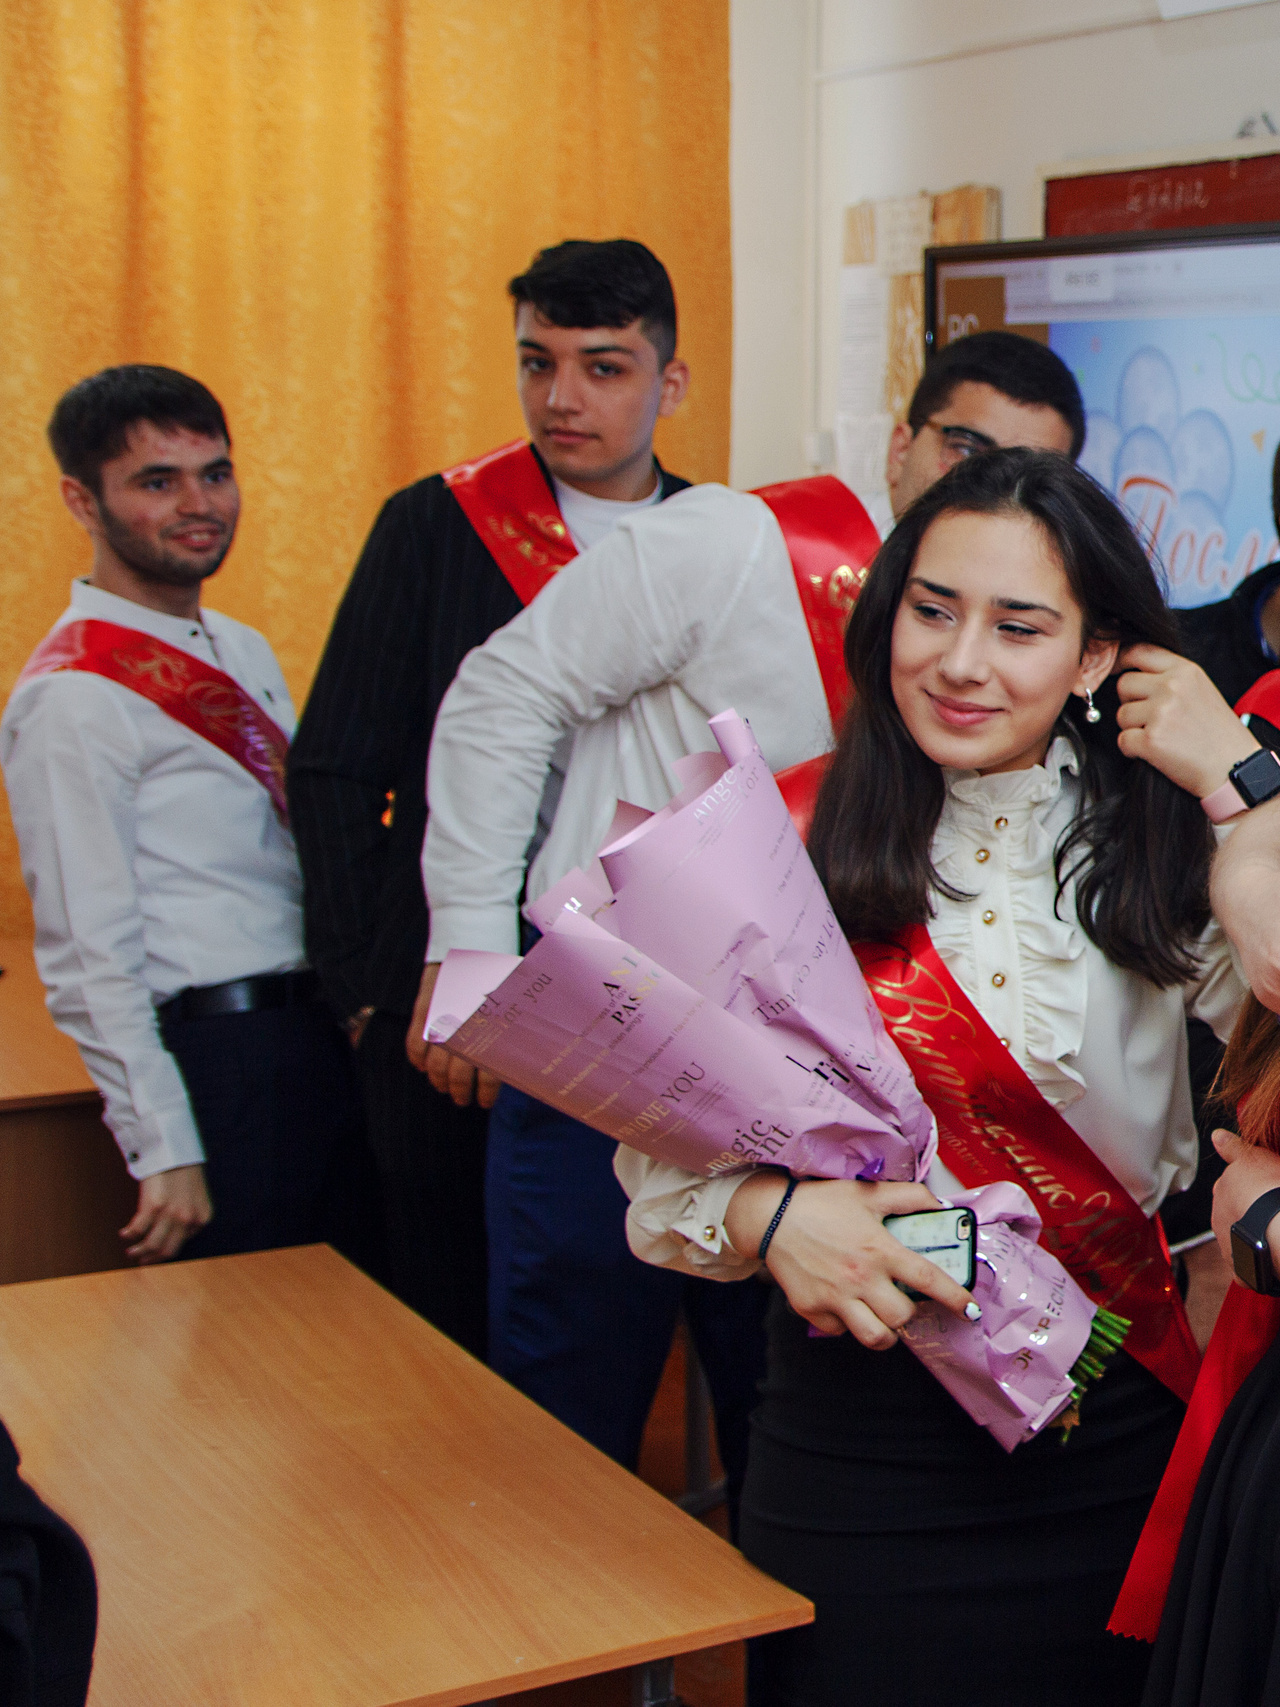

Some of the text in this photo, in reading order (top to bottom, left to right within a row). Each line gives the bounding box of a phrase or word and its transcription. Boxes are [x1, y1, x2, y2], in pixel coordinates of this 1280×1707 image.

[1119, 475, 1280, 590] Посл
[693, 763, 745, 827] Ange
[522, 972, 553, 1004] you
[660, 1061, 706, 1103] YOU
[860, 956, 1076, 1210] Выпускник
